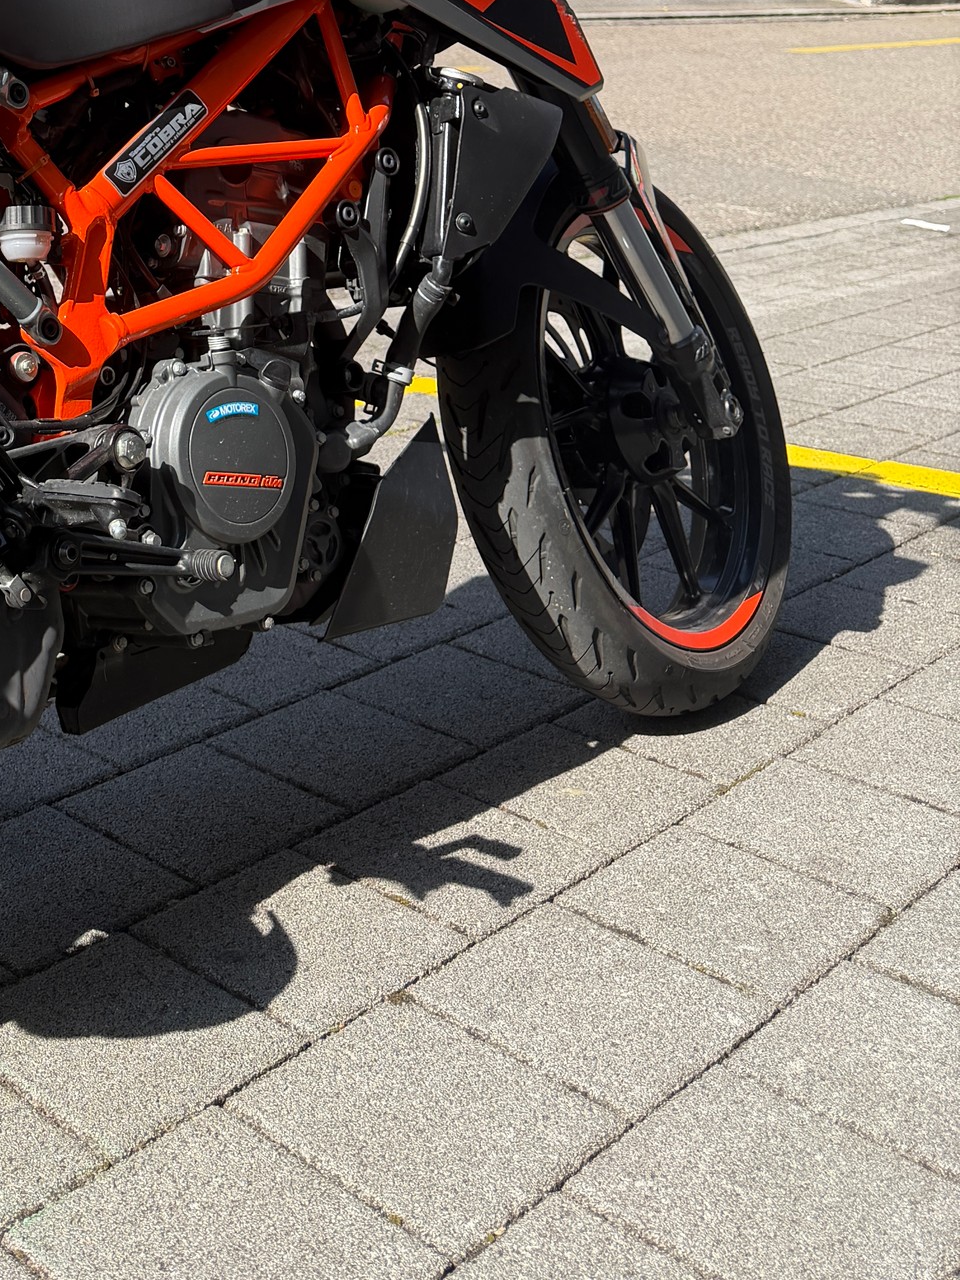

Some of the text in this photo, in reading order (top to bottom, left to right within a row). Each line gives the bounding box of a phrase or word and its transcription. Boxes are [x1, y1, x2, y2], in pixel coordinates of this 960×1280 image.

[133, 102, 203, 168] COBRA
[219, 402, 257, 415] MOTOREX
[205, 473, 283, 488] RACING KTM
